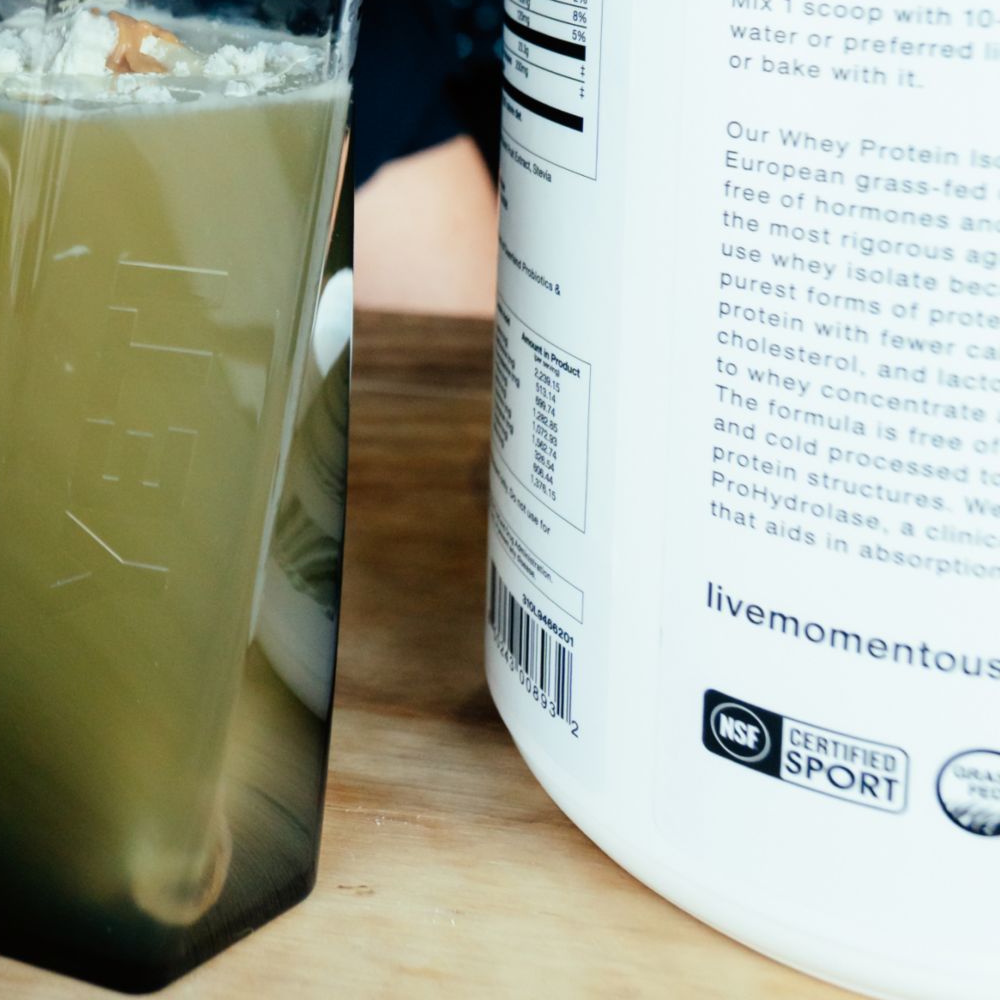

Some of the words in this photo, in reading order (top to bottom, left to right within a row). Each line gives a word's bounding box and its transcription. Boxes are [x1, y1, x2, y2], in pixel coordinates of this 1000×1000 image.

[571, 29, 586, 42] 5%
[572, 9, 587, 23] 8%
[803, 1, 883, 24] scoop
[894, 5, 952, 26] with
[730, 23, 798, 44] water
[807, 33, 833, 48] or
[843, 36, 974, 60] preferred
[729, 54, 752, 69] or
[762, 55, 821, 78] bake
[832, 64, 887, 85] with
[898, 69, 925, 89] it.
[726, 120, 770, 143] Our
[779, 128, 849, 159] Whey
[860, 138, 959, 166] Protein
[533, 163, 552, 183] Stevia
[725, 150, 845, 185] European
[855, 173, 987, 201] grass-fed
[724, 180, 770, 205] free
[780, 192, 805, 210] of
[815, 195, 949, 230] hormones
[722, 211, 759, 232] the
[770, 221, 831, 246] most
[841, 231, 954, 262] rigorous
[522, 262, 553, 292] Probiotics
[555, 284, 561, 296] &
[721, 241, 762, 263] use
[771, 252, 836, 281] whey
[847, 261, 938, 291] isolate
[720, 271, 797, 301] purest
[807, 286, 881, 316] forms
[891, 302, 920, 319] of
[718, 301, 804, 332] protein
[814, 320, 869, 344] with
[880, 329, 955, 355] fewer
[521, 332, 543, 355] Amount
[543, 347, 550, 358] in
[551, 353, 581, 379] Product
[717, 330, 866, 377] cholesterol,
[877, 363, 927, 384] and
[716, 357, 738, 377] to
[748, 367, 811, 397] whey
[820, 383, 986, 423] concentrate
[715, 383, 758, 411] The
[768, 399, 866, 436] formula
[876, 419, 897, 441] is
[908, 427, 962, 451] free
[973, 437, 1000, 454] of
[713, 416, 756, 441] and
[765, 431, 818, 456] cold
[828, 445, 969, 483] processed
[711, 470, 889, 534] ProHydrolase,
[899, 522, 914, 537] a
[713, 445, 797, 482] protein
[807, 470, 952, 513] structures.
[964, 495, 1000, 518] We
[540, 519, 551, 535] for
[710, 499, 757, 530] that
[765, 521, 816, 546] aids
[826, 533, 849, 553] in
[859, 543, 1000, 579] absorption
[706, 581, 1000, 680] livemomentous
[519, 669, 557, 718] 00893
[570, 719, 580, 738] 2
[719, 712, 761, 750] NSF
[790, 727, 896, 772] CERTIFIED
[785, 751, 898, 802] SPORT
